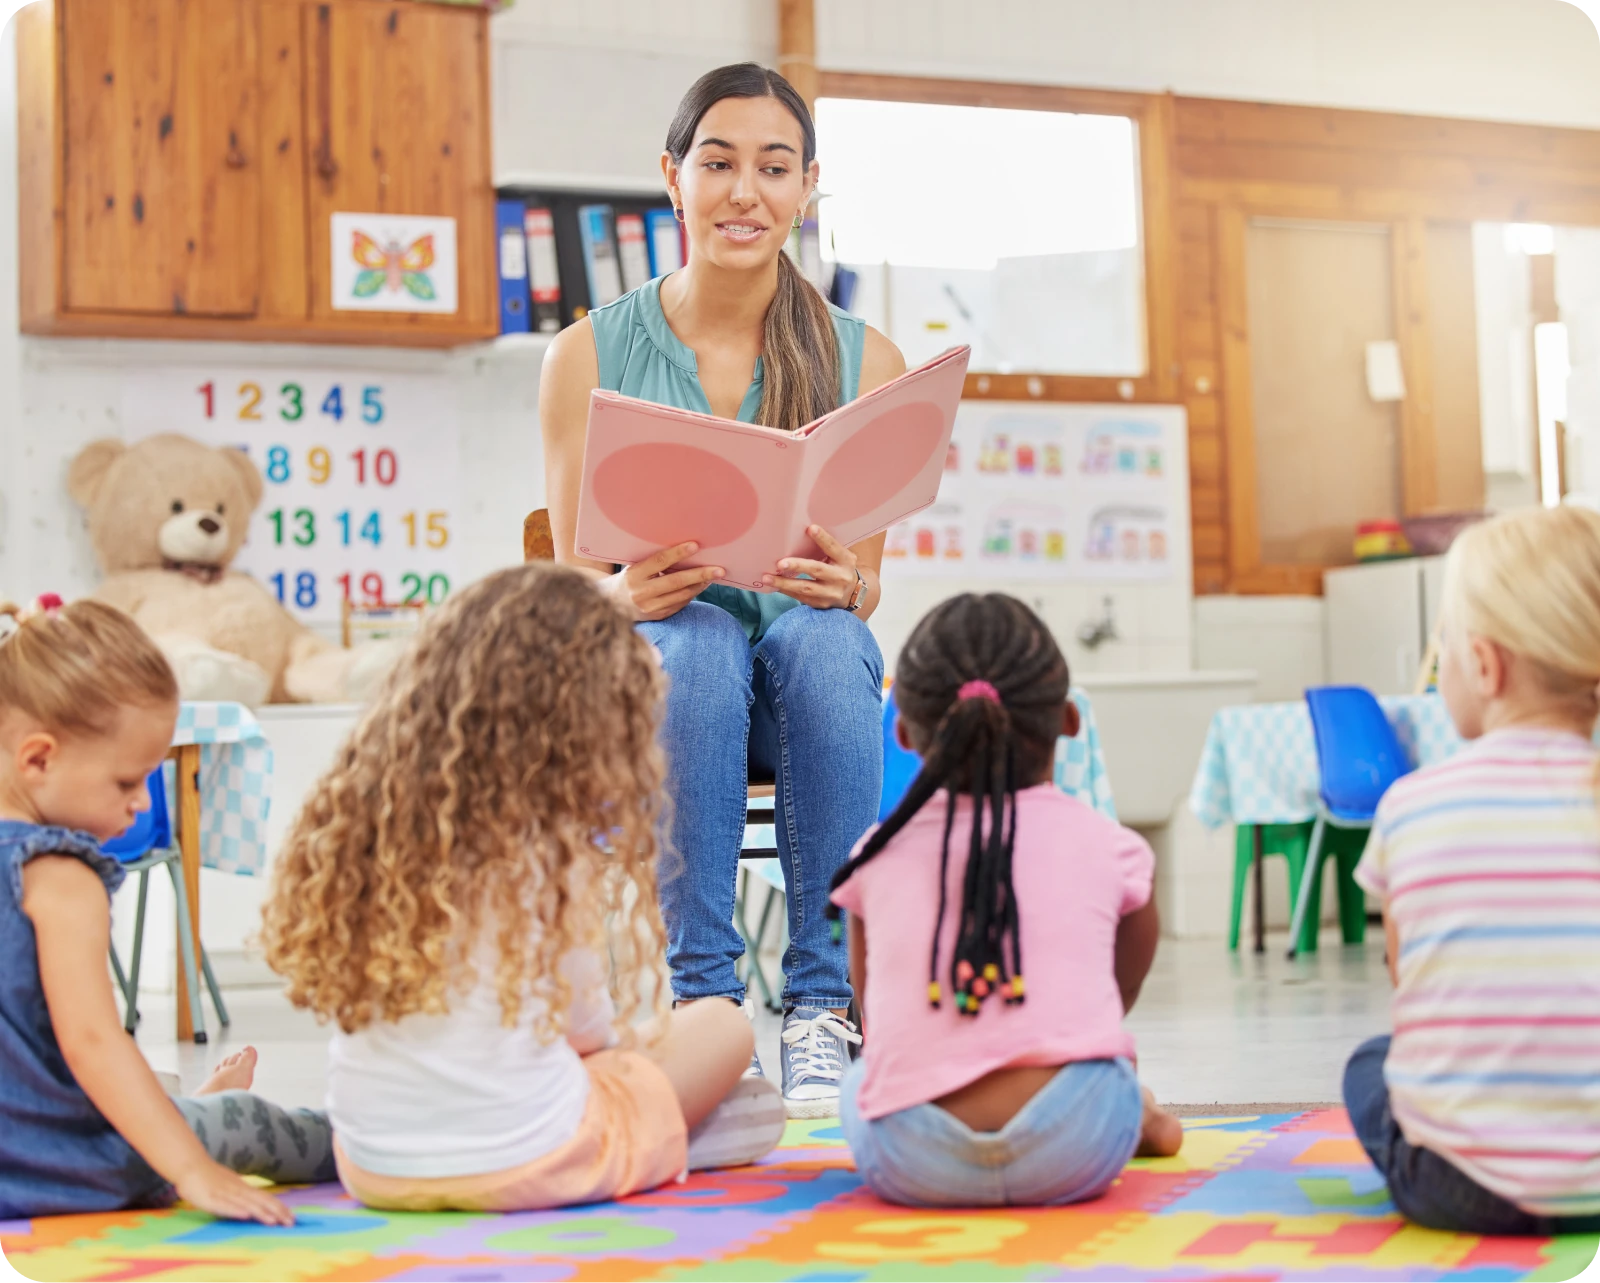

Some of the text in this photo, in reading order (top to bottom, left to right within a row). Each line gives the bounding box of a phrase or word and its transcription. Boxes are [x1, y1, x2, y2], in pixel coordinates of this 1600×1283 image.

[198, 381, 384, 424] 1 2 3 4 5
[266, 446, 397, 486] 8 9 10
[268, 508, 449, 548] 13 14 15
[270, 571, 449, 609] 18 19 20
[813, 1216, 1029, 1259] 3
[1178, 1223, 1404, 1256] H
